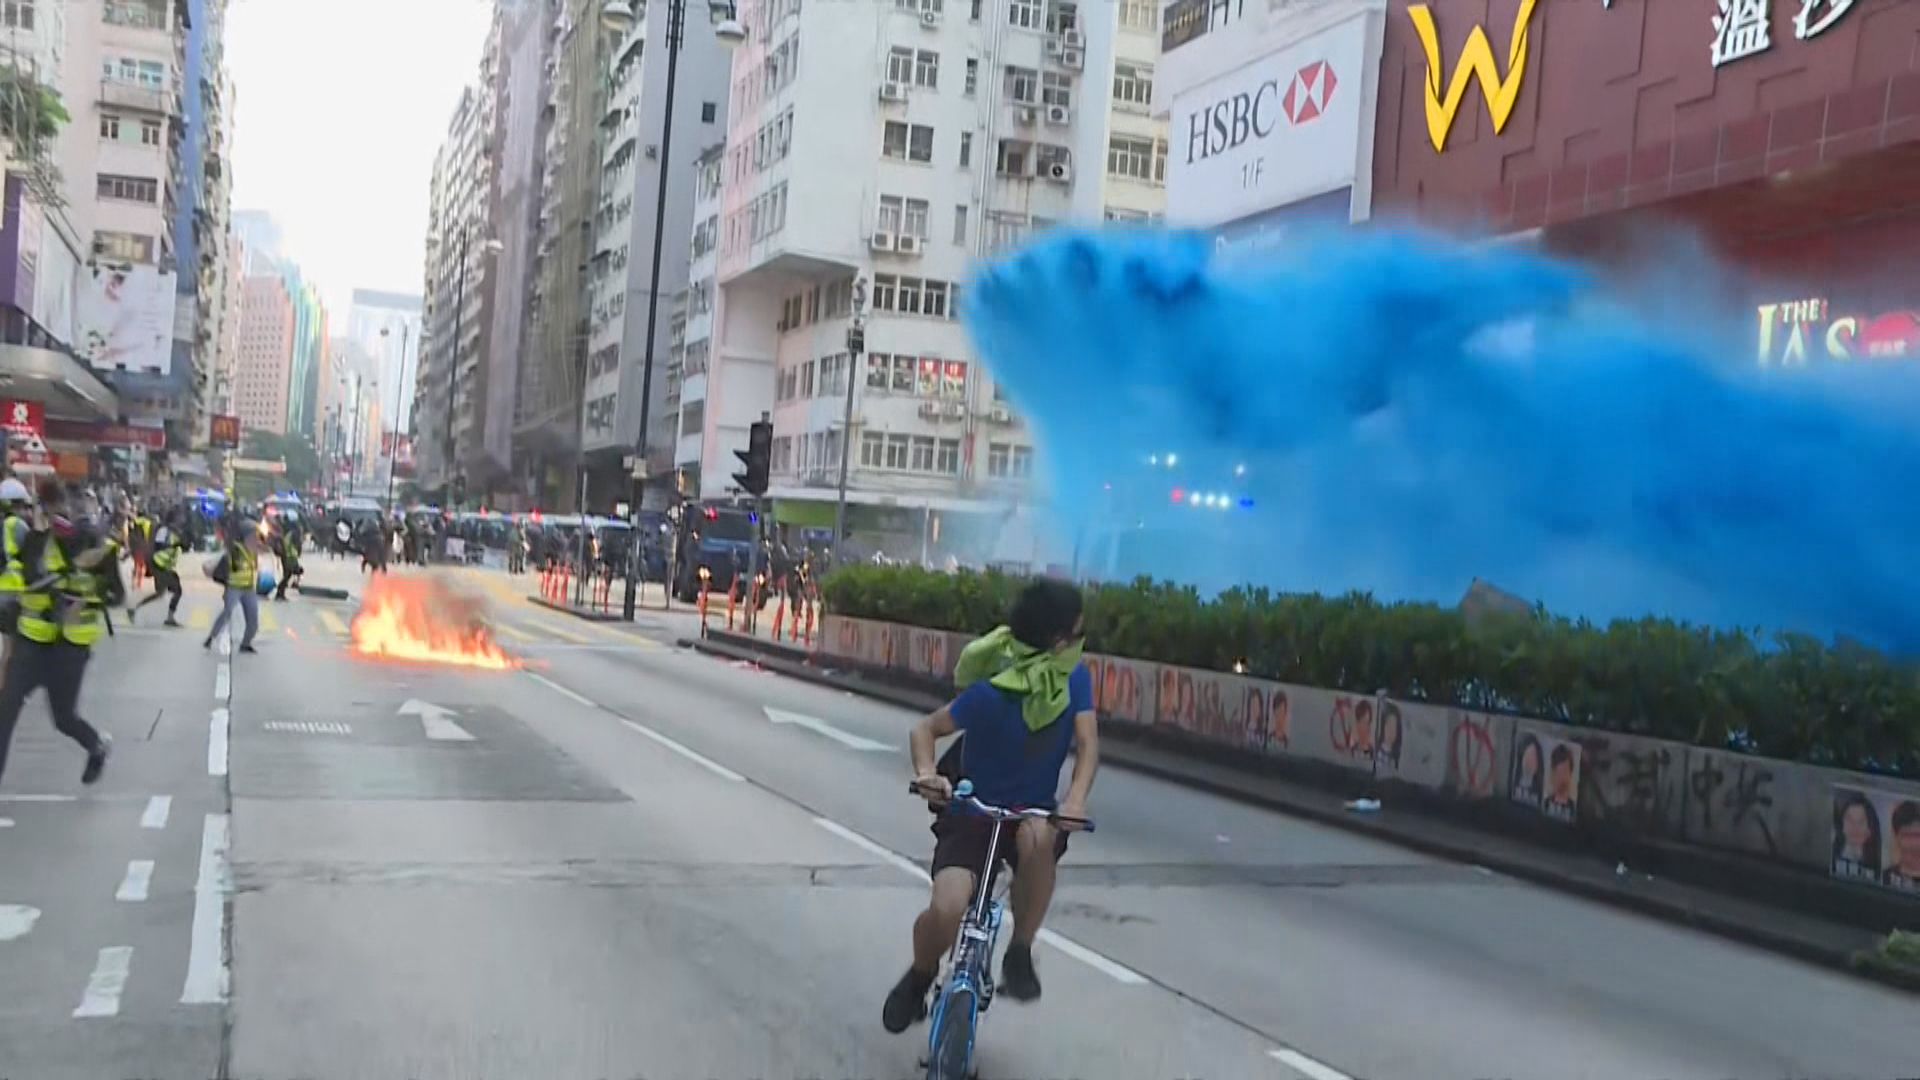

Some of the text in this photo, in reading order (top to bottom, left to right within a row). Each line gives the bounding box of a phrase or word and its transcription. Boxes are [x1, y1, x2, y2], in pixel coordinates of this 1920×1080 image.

[1407, 0, 1536, 153] W
[1185, 79, 1278, 165] HSBC
[1241, 157, 1265, 190] 1/F
[1781, 298, 1820, 324] THE
